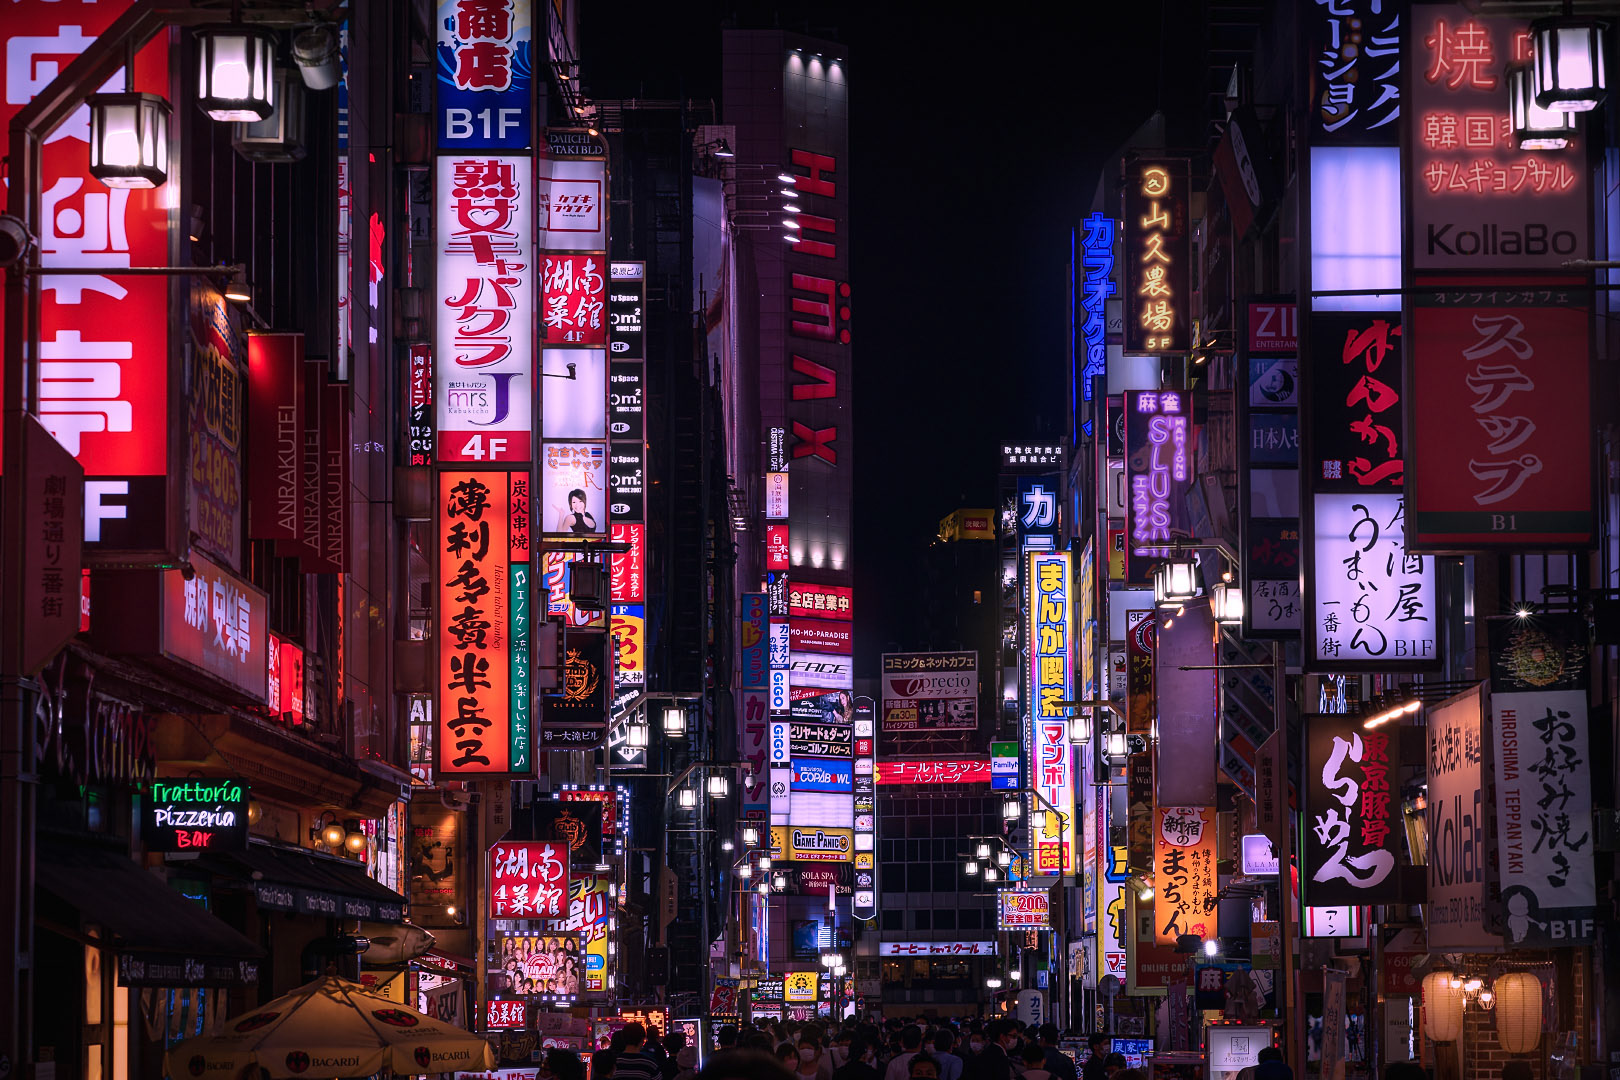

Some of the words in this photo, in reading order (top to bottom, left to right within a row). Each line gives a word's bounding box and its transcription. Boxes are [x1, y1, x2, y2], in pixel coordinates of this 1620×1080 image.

[454, 0, 513, 91] 商店
[446, 108, 522, 139] B1F
[550, 134, 591, 144] DAIICHI
[581, 146, 604, 155] BLD
[1426, 159, 1574, 194] サムギョプサル
[553, 203, 596, 213] ラウンジ
[559, 194, 592, 203] カブキ
[1427, 224, 1576, 256] KollaBo
[445, 159, 526, 372] 熟女キャバクラ
[1141, 200, 1172, 331] 山久農場
[544, 262, 604, 297] 湖南
[618, 294, 639, 302] Space
[1435, 292, 1568, 304] オンラインカフェ
[562, 332, 585, 342] 4F
[614, 343, 625, 351] 5F
[1147, 337, 1171, 349] 5F
[413, 355, 426, 421] 肉ダイニング
[1138, 393, 1180, 412] 麻雀
[1462, 314, 1541, 506] ステップ
[614, 423, 625, 432] 4F
[461, 435, 508, 461] 4F
[1004, 446, 1062, 455] 歌舞伎町商店
[278, 403, 296, 531] ANRAKUTEI
[303, 428, 320, 549] ANRAKUTEI
[326, 450, 343, 566] ANRAKUTEI
[511, 479, 530, 551] 炭火串焼
[614, 505, 625, 513] 3F
[1490, 514, 1517, 531] B1
[41, 474, 67, 619] 劇場通り一番街
[773, 534, 788, 562] 白木屋
[611, 528, 626, 601] リレッシュ
[630, 573, 640, 598] ホステル
[1342, 503, 1388, 657] うまいもん
[612, 606, 629, 615] 1F
[789, 592, 850, 612] 全店営業中
[184, 574, 208, 632] 焼肉
[212, 577, 250, 662] 安楽亭
[1131, 613, 1144, 622] 3F
[1322, 600, 1343, 658] 一番街
[770, 636, 779, 664] の鉄人
[779, 624, 789, 664] カラオケ
[1038, 559, 1068, 720] まんが喫茶
[1393, 638, 1432, 657] B1F
[790, 661, 850, 675] FACE
[885, 656, 975, 670] コミック&ネットカフェ
[620, 672, 643, 683] 天神
[906, 673, 970, 695] aprecio
[886, 700, 918, 709] 新宿最大
[544, 731, 600, 741] 第一大滝ビル
[1501, 709, 1519, 780] HIROSHIMA
[808, 743, 829, 754] ゴルフ
[1431, 722, 1462, 777] 炭火焼肉
[1042, 725, 1065, 807] マンボー
[913, 773, 962, 783] ハンバーグ
[1007, 777, 1017, 787] 酒
[1360, 731, 1390, 854] 東京豚骨
[1534, 706, 1591, 894] お好み焼き
[177, 829, 211, 849] Bar
[794, 832, 815, 847] GAME
[818, 832, 839, 848] PANIC
[495, 847, 564, 881] 湖南
[1041, 858, 1068, 868] OPEN
[1202, 848, 1212, 887] 博多もつ鍋
[801, 871, 819, 881] SOLA
[821, 872, 835, 881] SPA
[511, 884, 564, 917] 菜館
[1162, 848, 1190, 937] まっちゃん
[1549, 920, 1595, 944] B1F
[891, 944, 927, 954] コーヒー
[953, 943, 980, 954] クール
[1141, 964, 1169, 974] ONLINE
[1115, 1041, 1137, 1052] 炭家
